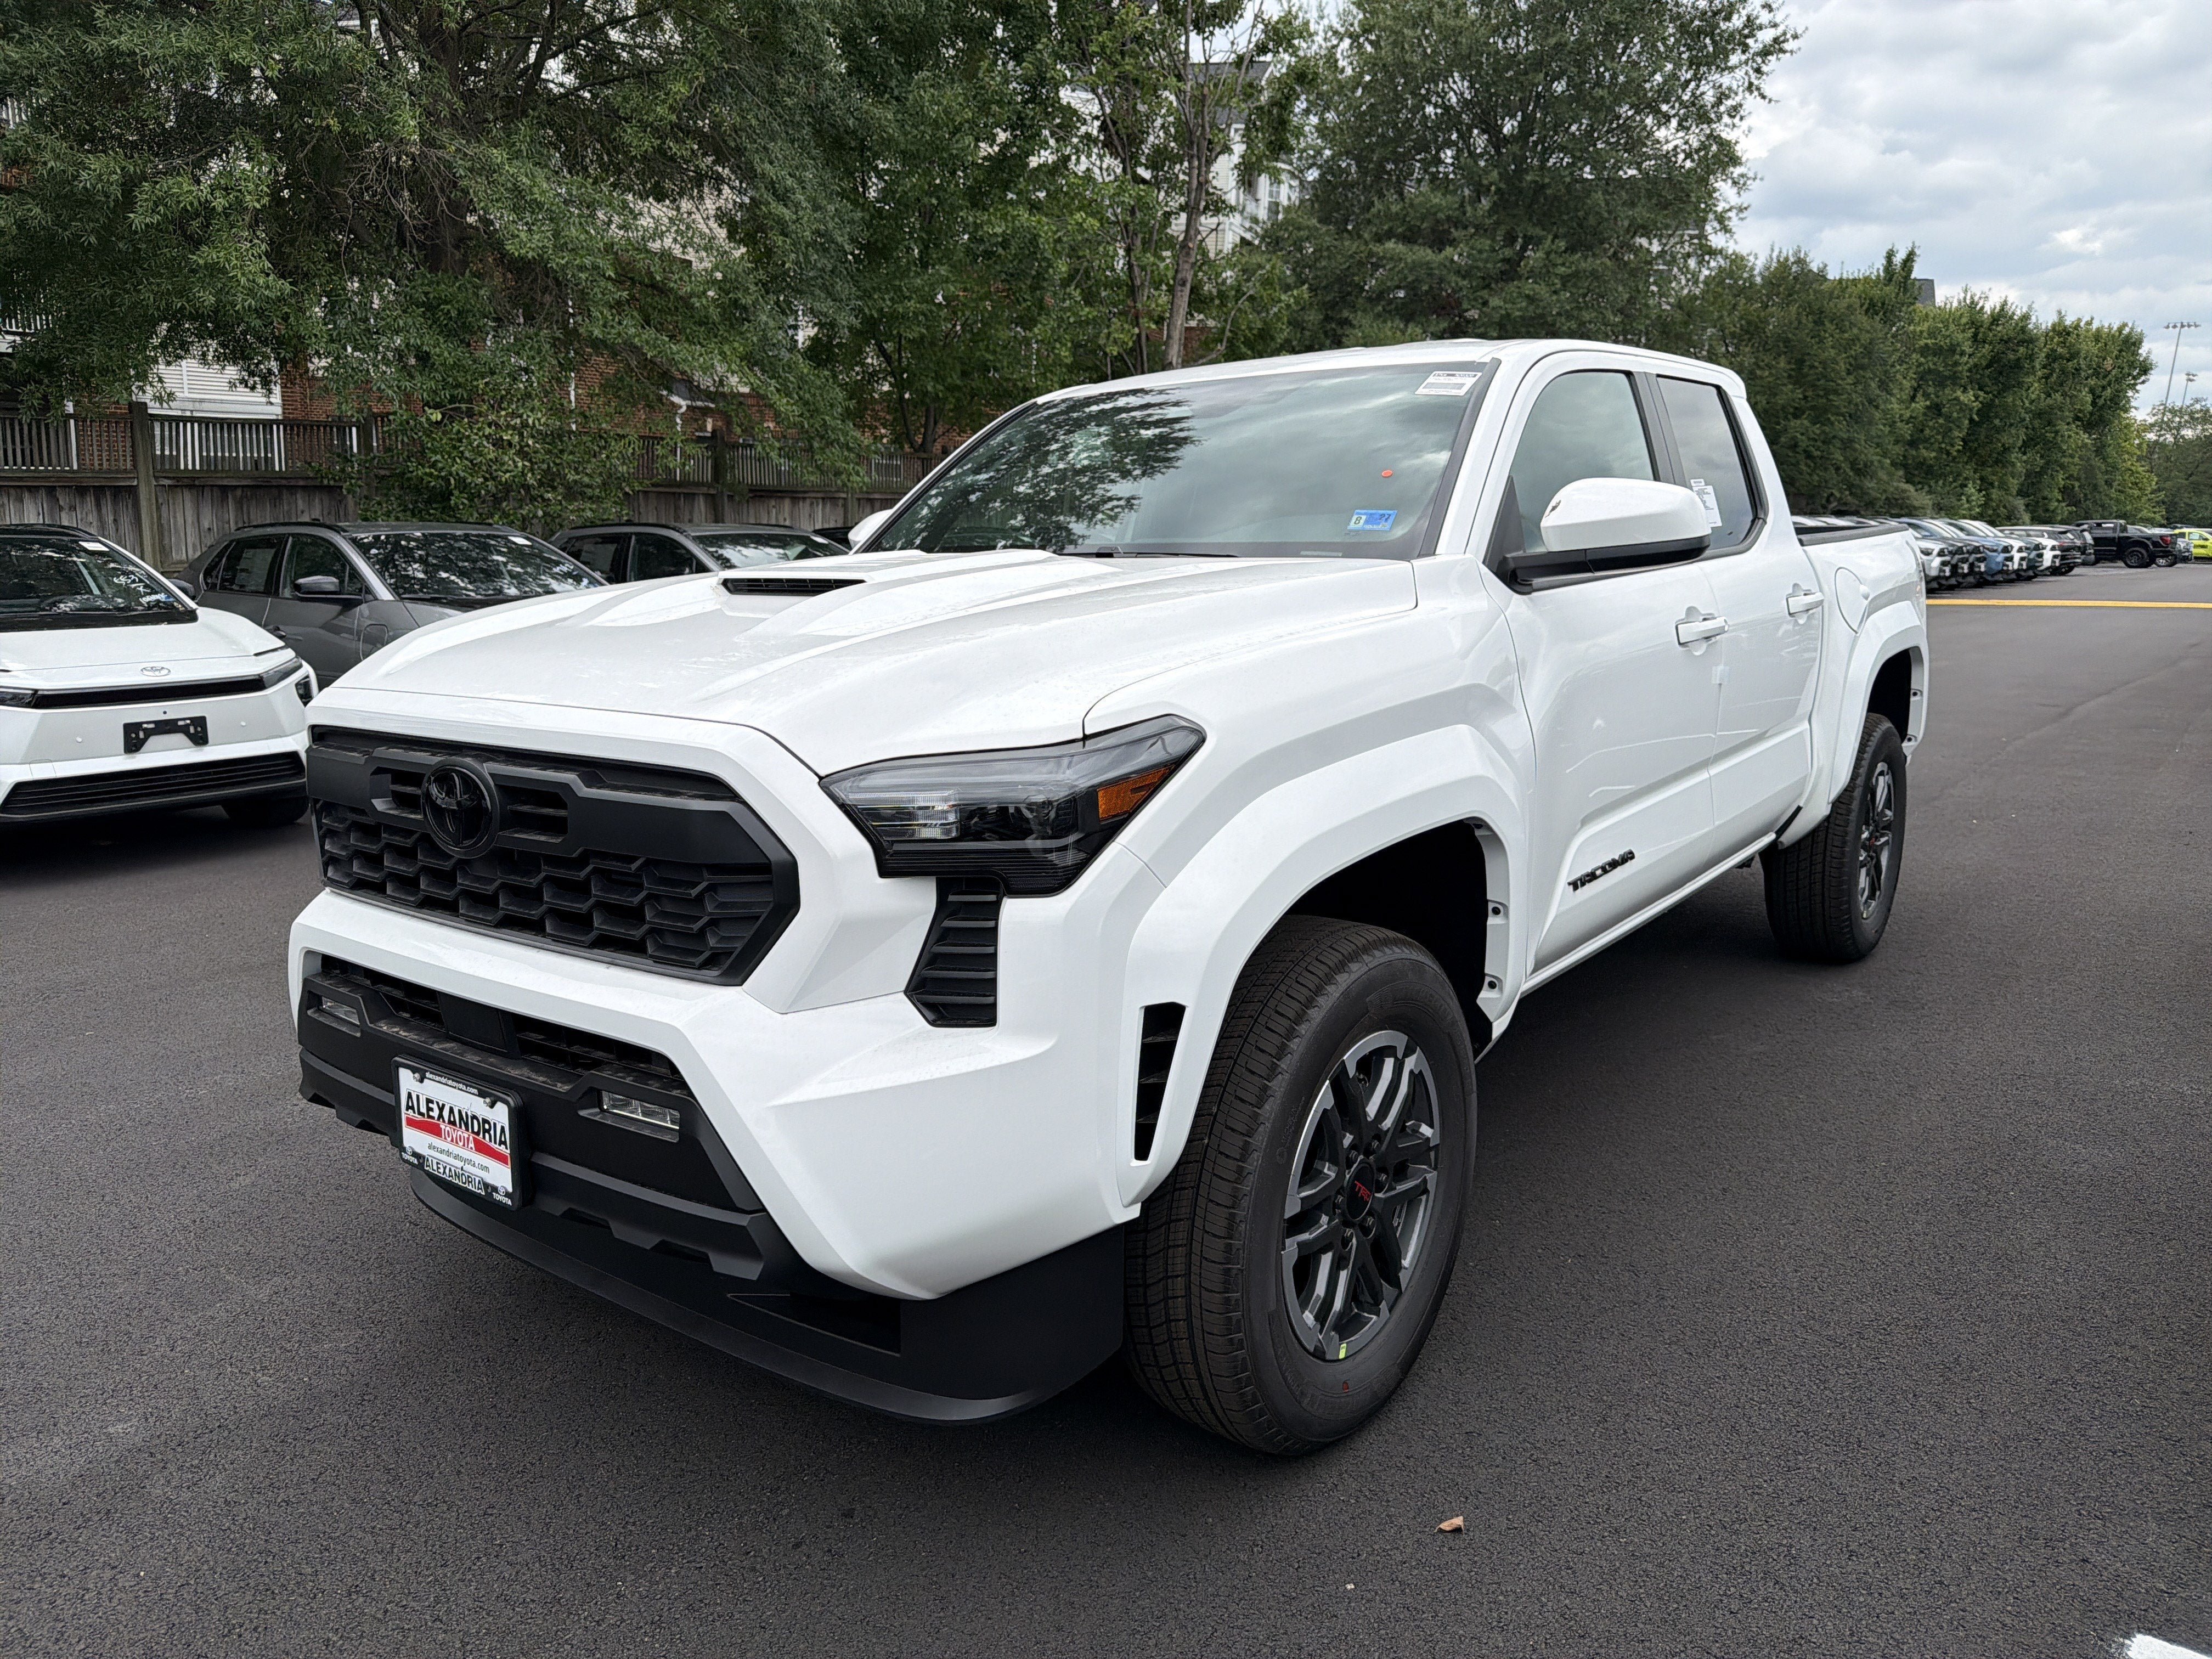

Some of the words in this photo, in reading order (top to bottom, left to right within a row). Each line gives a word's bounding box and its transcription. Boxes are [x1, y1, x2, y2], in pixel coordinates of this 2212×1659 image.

[1353, 516, 1362, 525] 8
[1378, 513, 1391, 523] 27
[1567, 848, 1635, 893] TACOMA
[425, 1071, 478, 1095] alexandriatoyota.com
[405, 1091, 510, 1152] ALEXANDRIA
[439, 1124, 476, 1151] TOYOTA
[402, 1153, 419, 1165] TOYOTA
[427, 1142, 490, 1174] alexandriatoyota.com
[425, 1155, 485, 1195] ALEXANDRIA
[492, 1192, 512, 1206] TOYOTA
[1354, 1180, 1372, 1203] TRD
